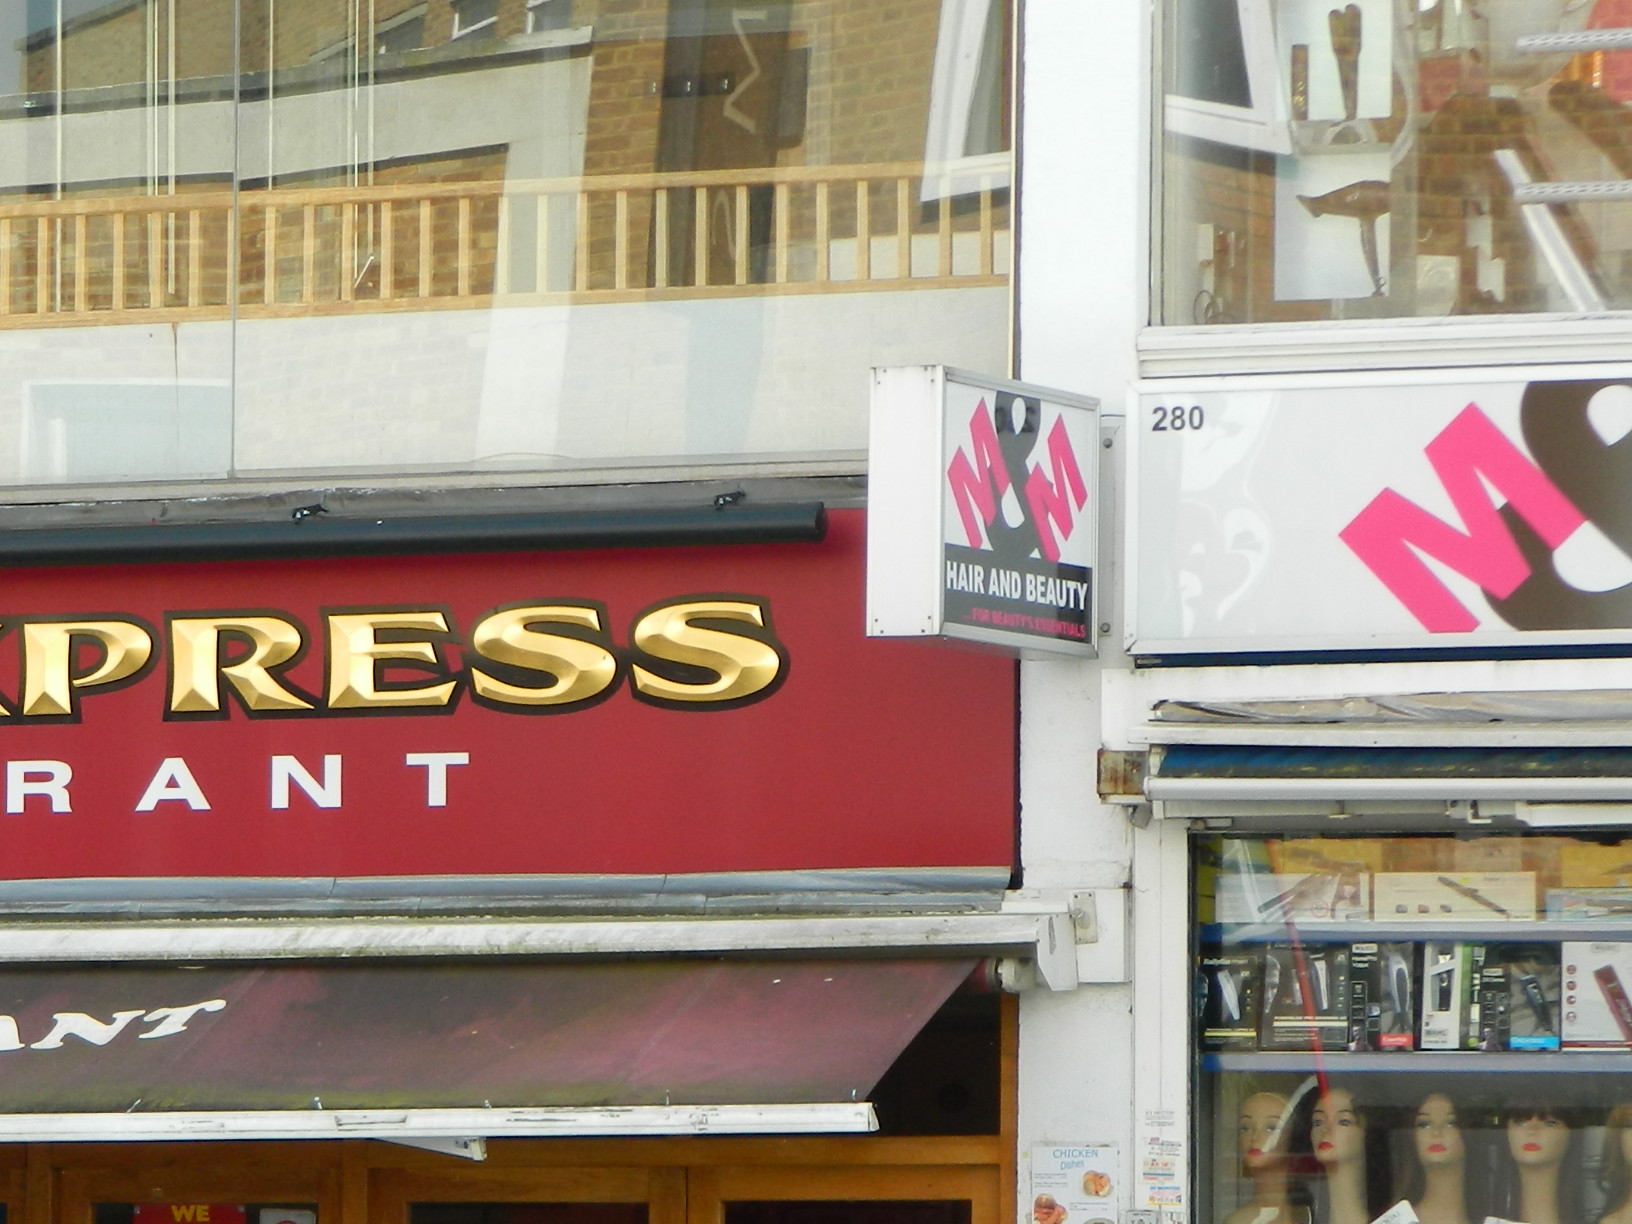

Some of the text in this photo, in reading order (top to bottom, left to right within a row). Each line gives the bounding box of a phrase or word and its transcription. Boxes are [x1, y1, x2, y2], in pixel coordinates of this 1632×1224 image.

[1153, 406, 1205, 432] 280
[946, 560, 1088, 610] HAIR AND BEAUTY
[1052, 1148, 1100, 1159] CHICKEN
[171, 1205, 210, 1223] WE
